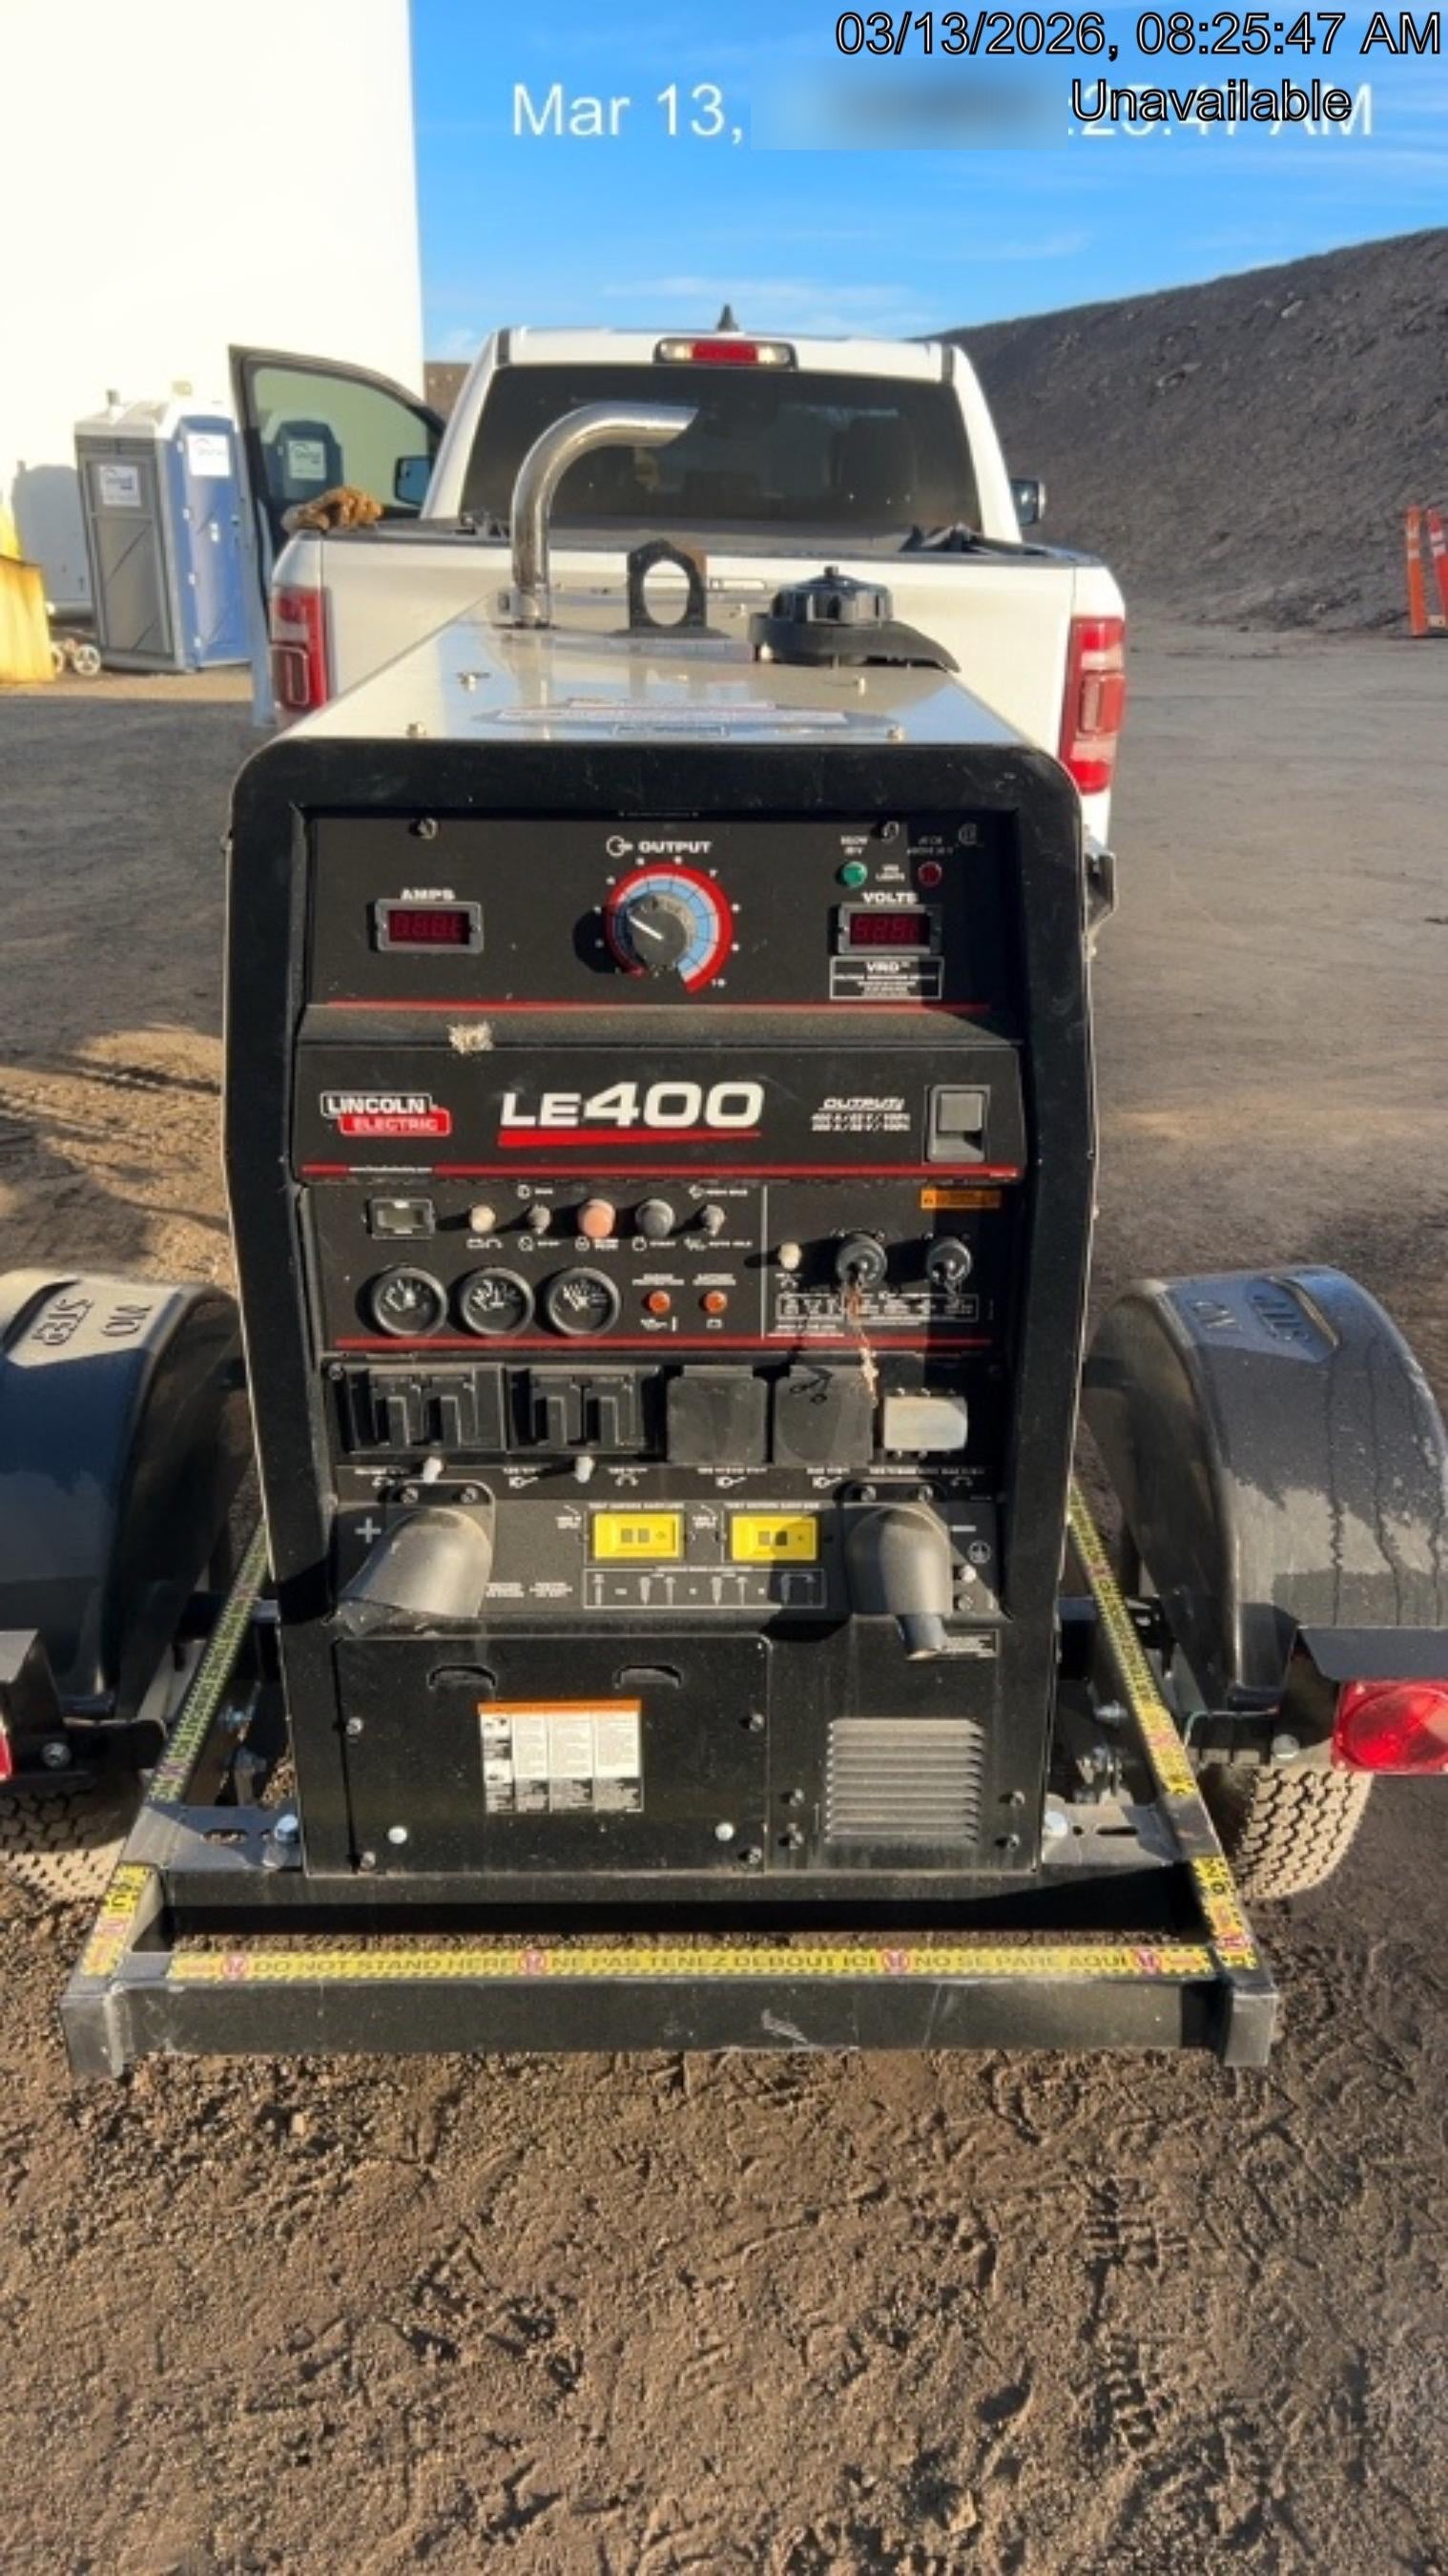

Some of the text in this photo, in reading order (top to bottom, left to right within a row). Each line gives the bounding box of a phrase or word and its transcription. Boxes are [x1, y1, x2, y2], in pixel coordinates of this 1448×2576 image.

[638, 841, 712, 855] OUTPUT
[399, 888, 456, 901] AMPS
[862, 892, 918, 904] VOLTS
[328, 1097, 425, 1114] LINCOLN
[501, 1082, 764, 1128] LE400
[354, 1118, 437, 1132] ELECTRIC
[254, 1957, 516, 1972] DO NOT STAND HERE
[550, 1955, 878, 1968] NE PAS TENEZ DEBOUT ICI
[914, 1955, 951, 1967] NO
[1068, 1955, 1127, 1967] AQUI
